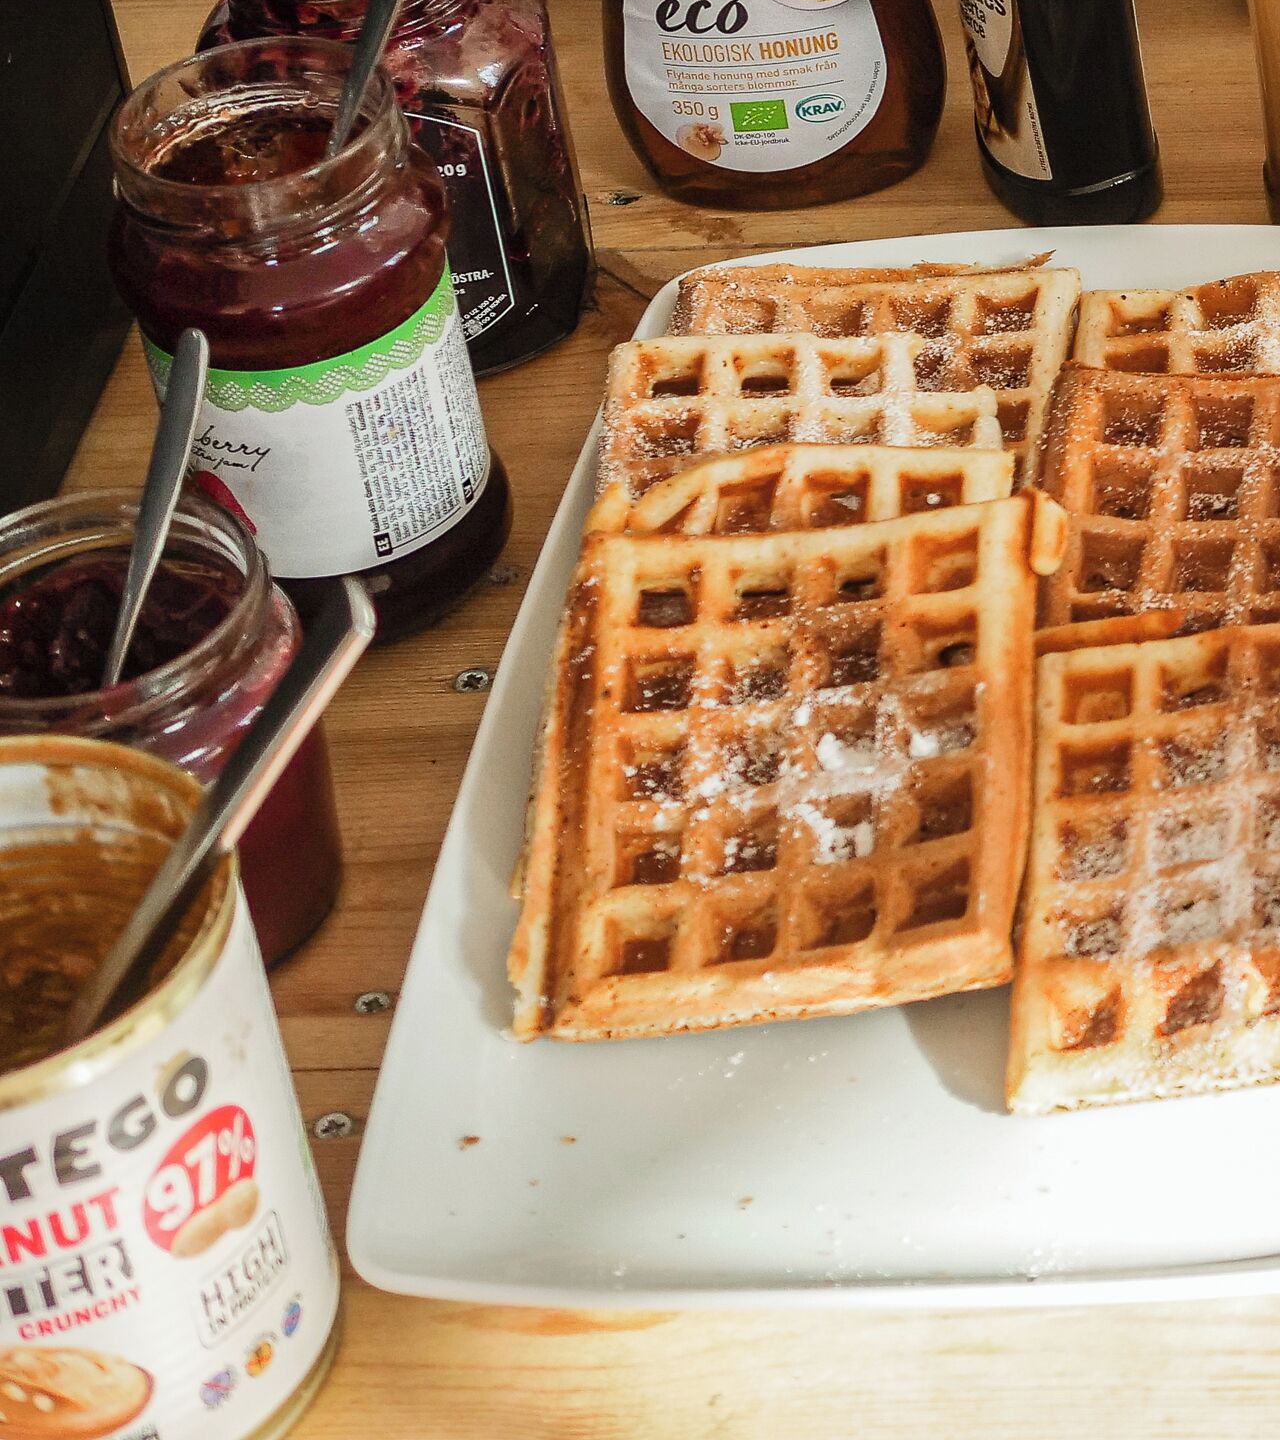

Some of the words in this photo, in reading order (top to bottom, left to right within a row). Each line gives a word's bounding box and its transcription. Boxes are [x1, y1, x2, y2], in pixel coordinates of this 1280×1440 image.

[661, 41, 755, 63] EKOLOGISK
[758, 32, 839, 60] HONUNG
[666, 69, 711, 82] Flytande
[713, 70, 753, 82] honung
[756, 68, 780, 79] med
[782, 64, 813, 76] smak
[815, 60, 838, 72] från
[669, 82, 704, 94] många
[706, 82, 745, 92] sorters
[672, 100, 704, 116] 350
[708, 105, 720, 120] g
[213, 457, 250, 470] jam
[376, 537, 390, 553] EE
[147, 1112, 254, 1231] 97%
[0, 1187, 120, 1267] NUT
[201, 1226, 277, 1317] HIGH
[18, 1286, 141, 1341] CRUNCHY
